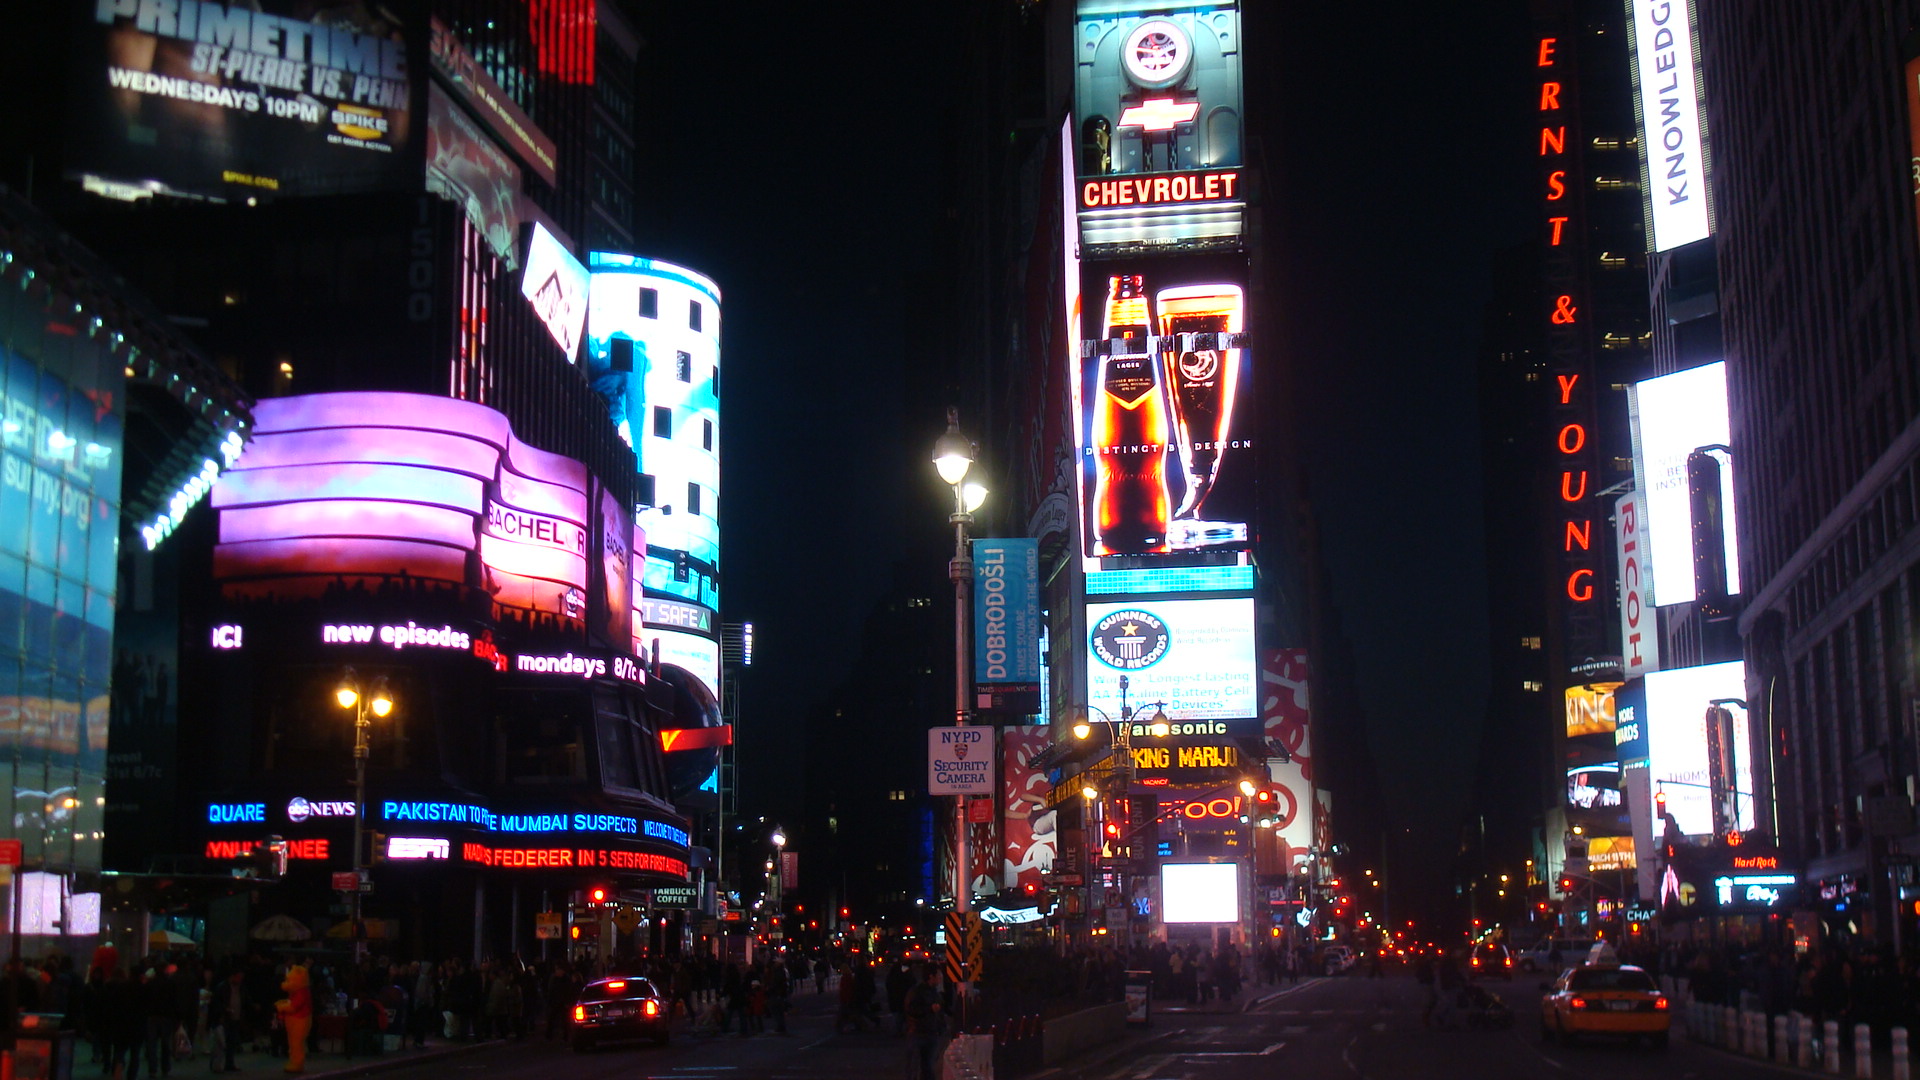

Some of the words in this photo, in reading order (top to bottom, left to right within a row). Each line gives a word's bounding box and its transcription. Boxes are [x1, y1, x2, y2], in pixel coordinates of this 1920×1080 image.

[96, 0, 406, 80] PRIMETIME
[191, 42, 308, 92] ST-PIERRE
[311, 65, 345, 99] VS.
[351, 74, 409, 112] PENN
[108, 66, 259, 112] WEDNESDAYS
[265, 95, 319, 123] 10PM
[1650, 0, 1689, 206] KNOWLEDG
[331, 109, 388, 132] SPIKE
[1538, 38, 1568, 246] ERNST
[222, 169, 280, 191] SPIKE.COM
[1084, 174, 1237, 207] CHEVROLET
[1551, 295, 1577, 324] &
[1195, 440, 1251, 451] DESIGN
[1557, 374, 1594, 601] YOUNG
[488, 506, 585, 553] BACHELR
[1621, 501, 1642, 668] RICOH
[658, 605, 698, 626] SAFE
[979, 548, 1007, 679] DOBRODOŠLI
[1099, 610, 1161, 631] GUINNESS
[323, 624, 374, 642] new
[380, 621, 470, 649] episodes
[1093, 636, 1124, 667] WORLD
[1126, 634, 1167, 669] RECORDS
[518, 653, 605, 678] mondays
[614, 657, 637, 680] 8/7c
[1582, 661, 1617, 672] UNIVERSAL
[1172, 687, 1220, 700] Battery
[941, 731, 981, 744] NYPD
[1118, 720, 1227, 736] Pansonic
[934, 759, 989, 772] SECURITY
[1131, 747, 1170, 769] KING
[936, 772, 986, 784] CAMERA
[209, 803, 266, 823] QUARE
[288, 803, 310, 815] abc
[309, 801, 356, 816] NEWS
[384, 801, 467, 823] PAKISTAN
[468, 804, 480, 821] TO
[501, 814, 568, 832] MUMBAI
[574, 813, 637, 835] SUSPECTS
[387, 837, 450, 859] ESPN
[494, 850, 573, 867] FEDERER
[578, 849, 595, 867] IN
[599, 850, 607, 867] 5
[609, 850, 634, 868] SETS
[634, 852, 650, 870] FOR
[650, 854, 666, 872] FIRST
[1734, 857, 1755, 868] Hard
[1756, 857, 1777, 869] Rock
[654, 887, 697, 896] ARBUCKS
[656, 895, 688, 903] COFFEE
